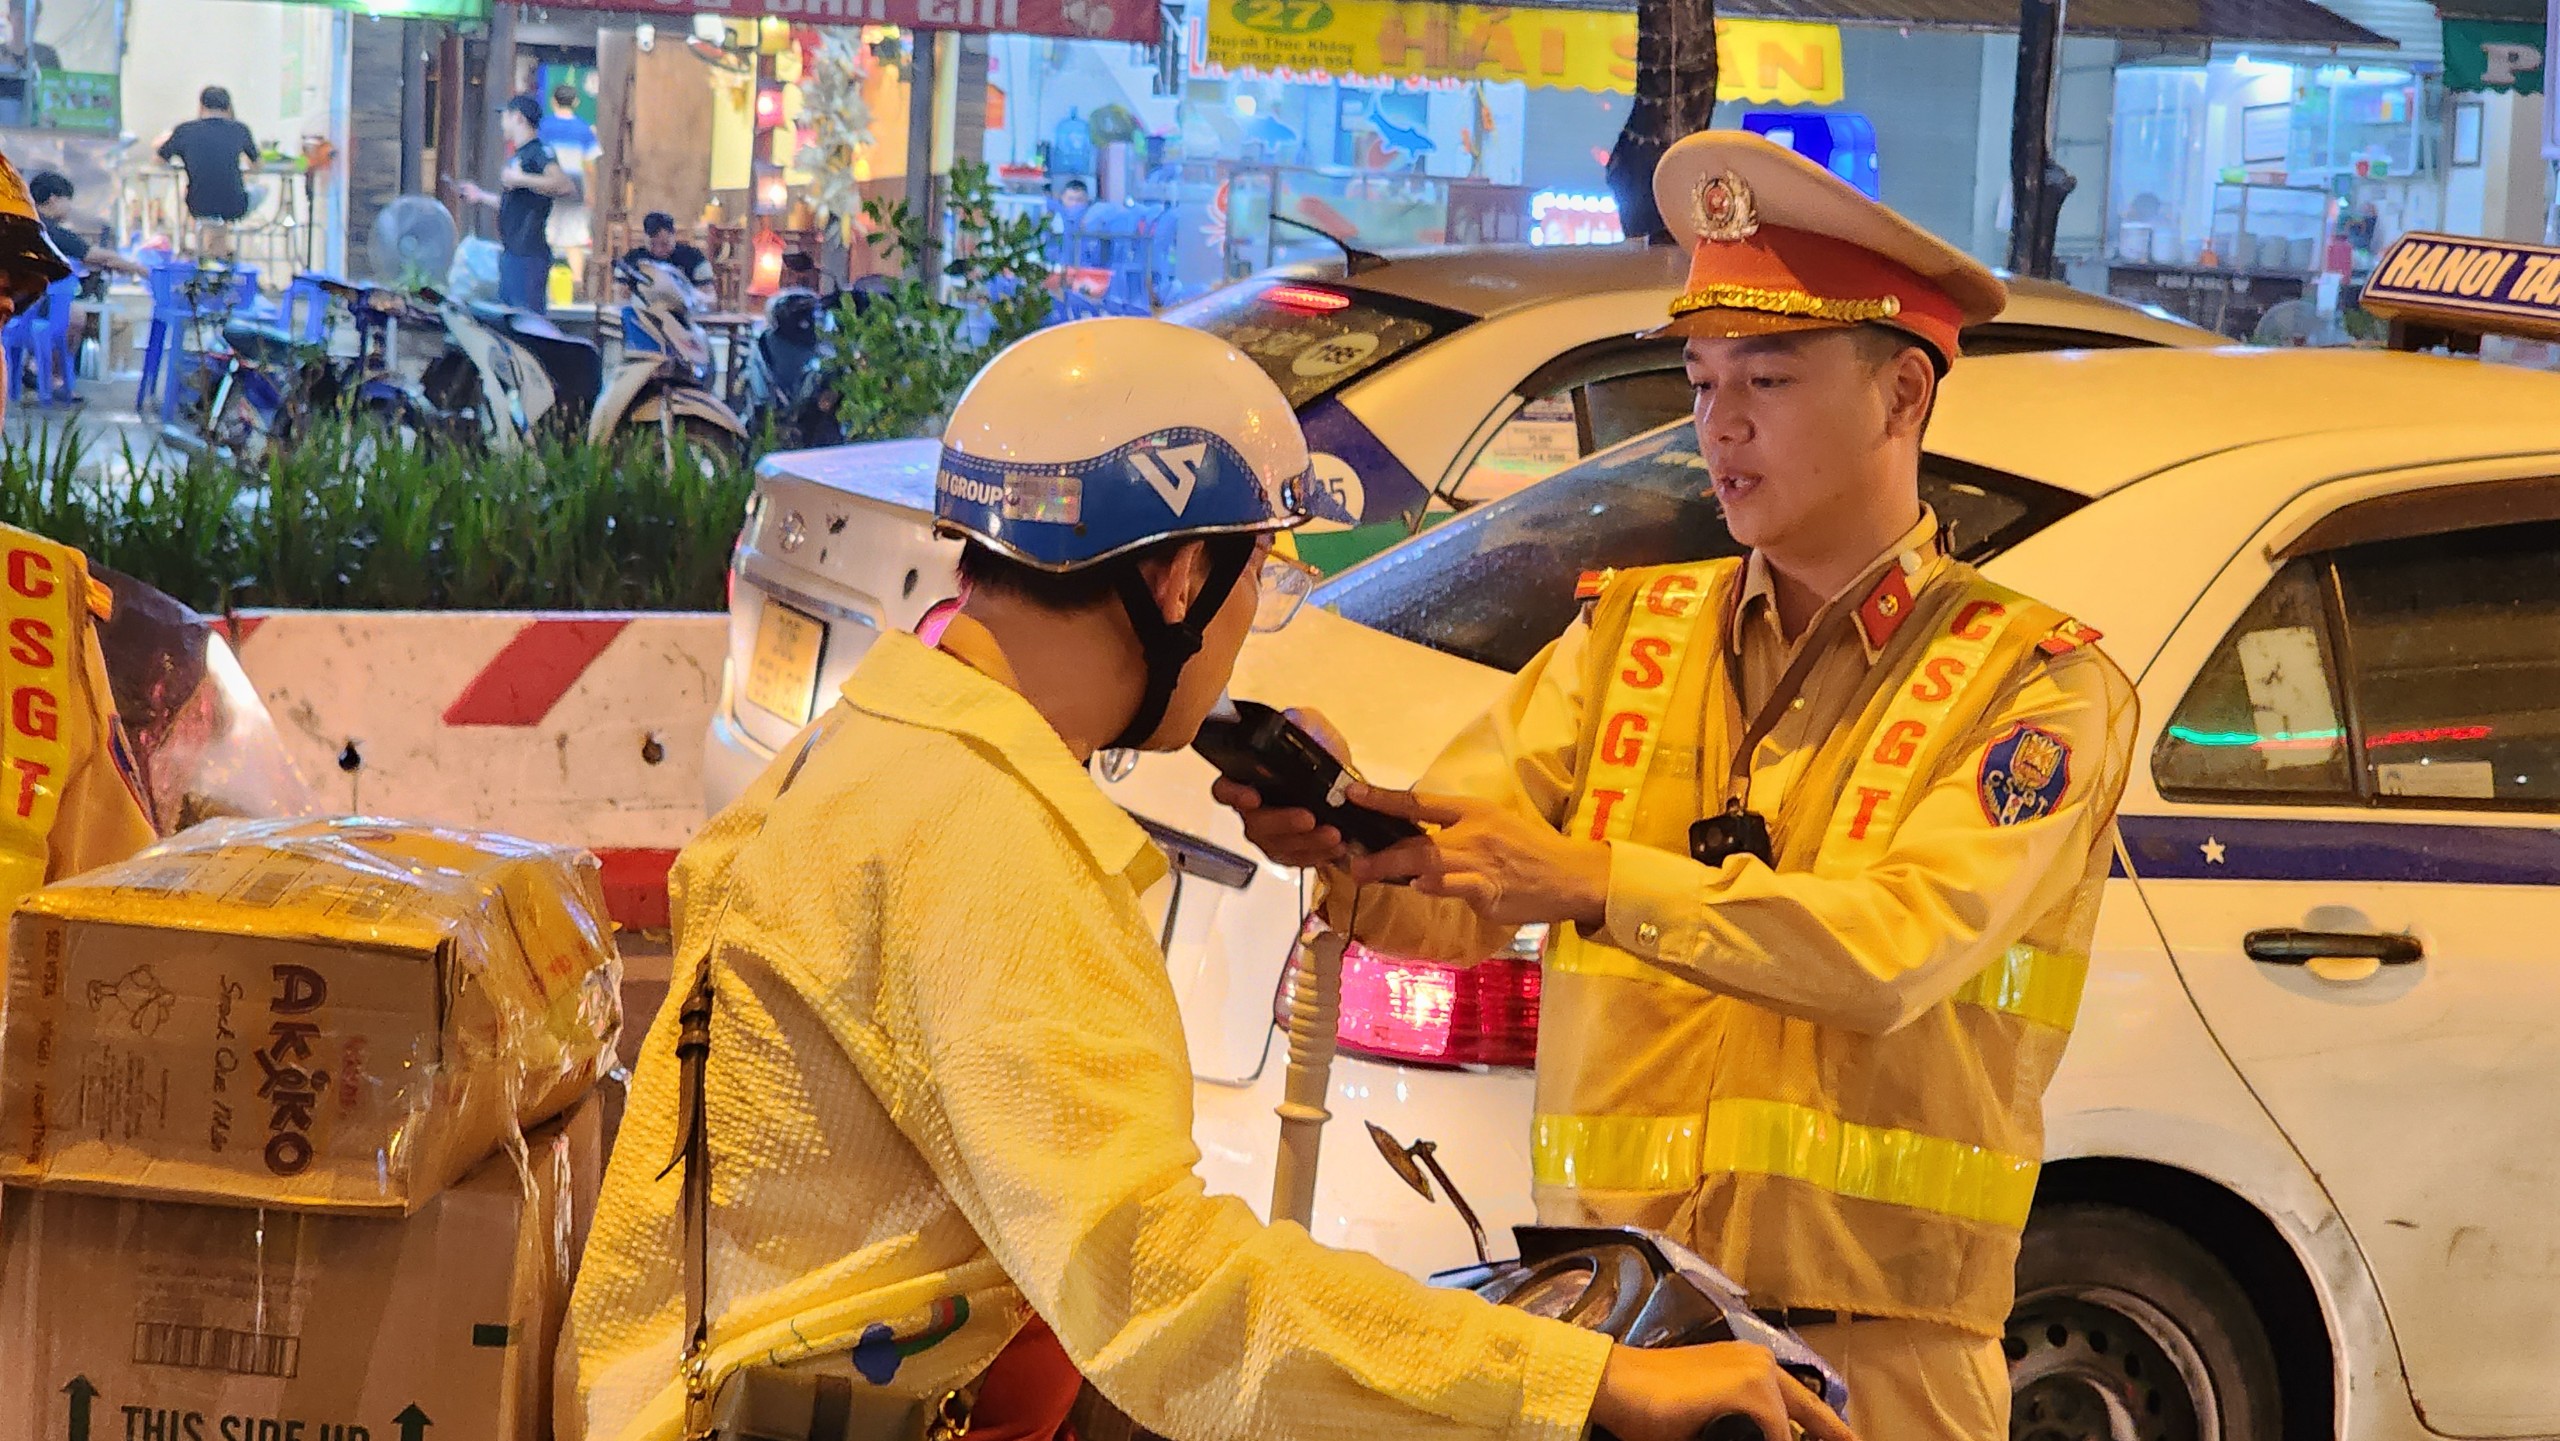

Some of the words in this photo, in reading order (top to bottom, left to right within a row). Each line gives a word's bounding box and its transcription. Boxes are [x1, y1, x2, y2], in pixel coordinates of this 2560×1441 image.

[1245, 0, 1322, 29] 27
[2379, 241, 2519, 298] HANOI
[950, 473, 1004, 507] GROUP
[7, 549, 58, 817] CSGT
[1589, 574, 1698, 841] CSGT
[1848, 600, 2006, 840] CSGT
